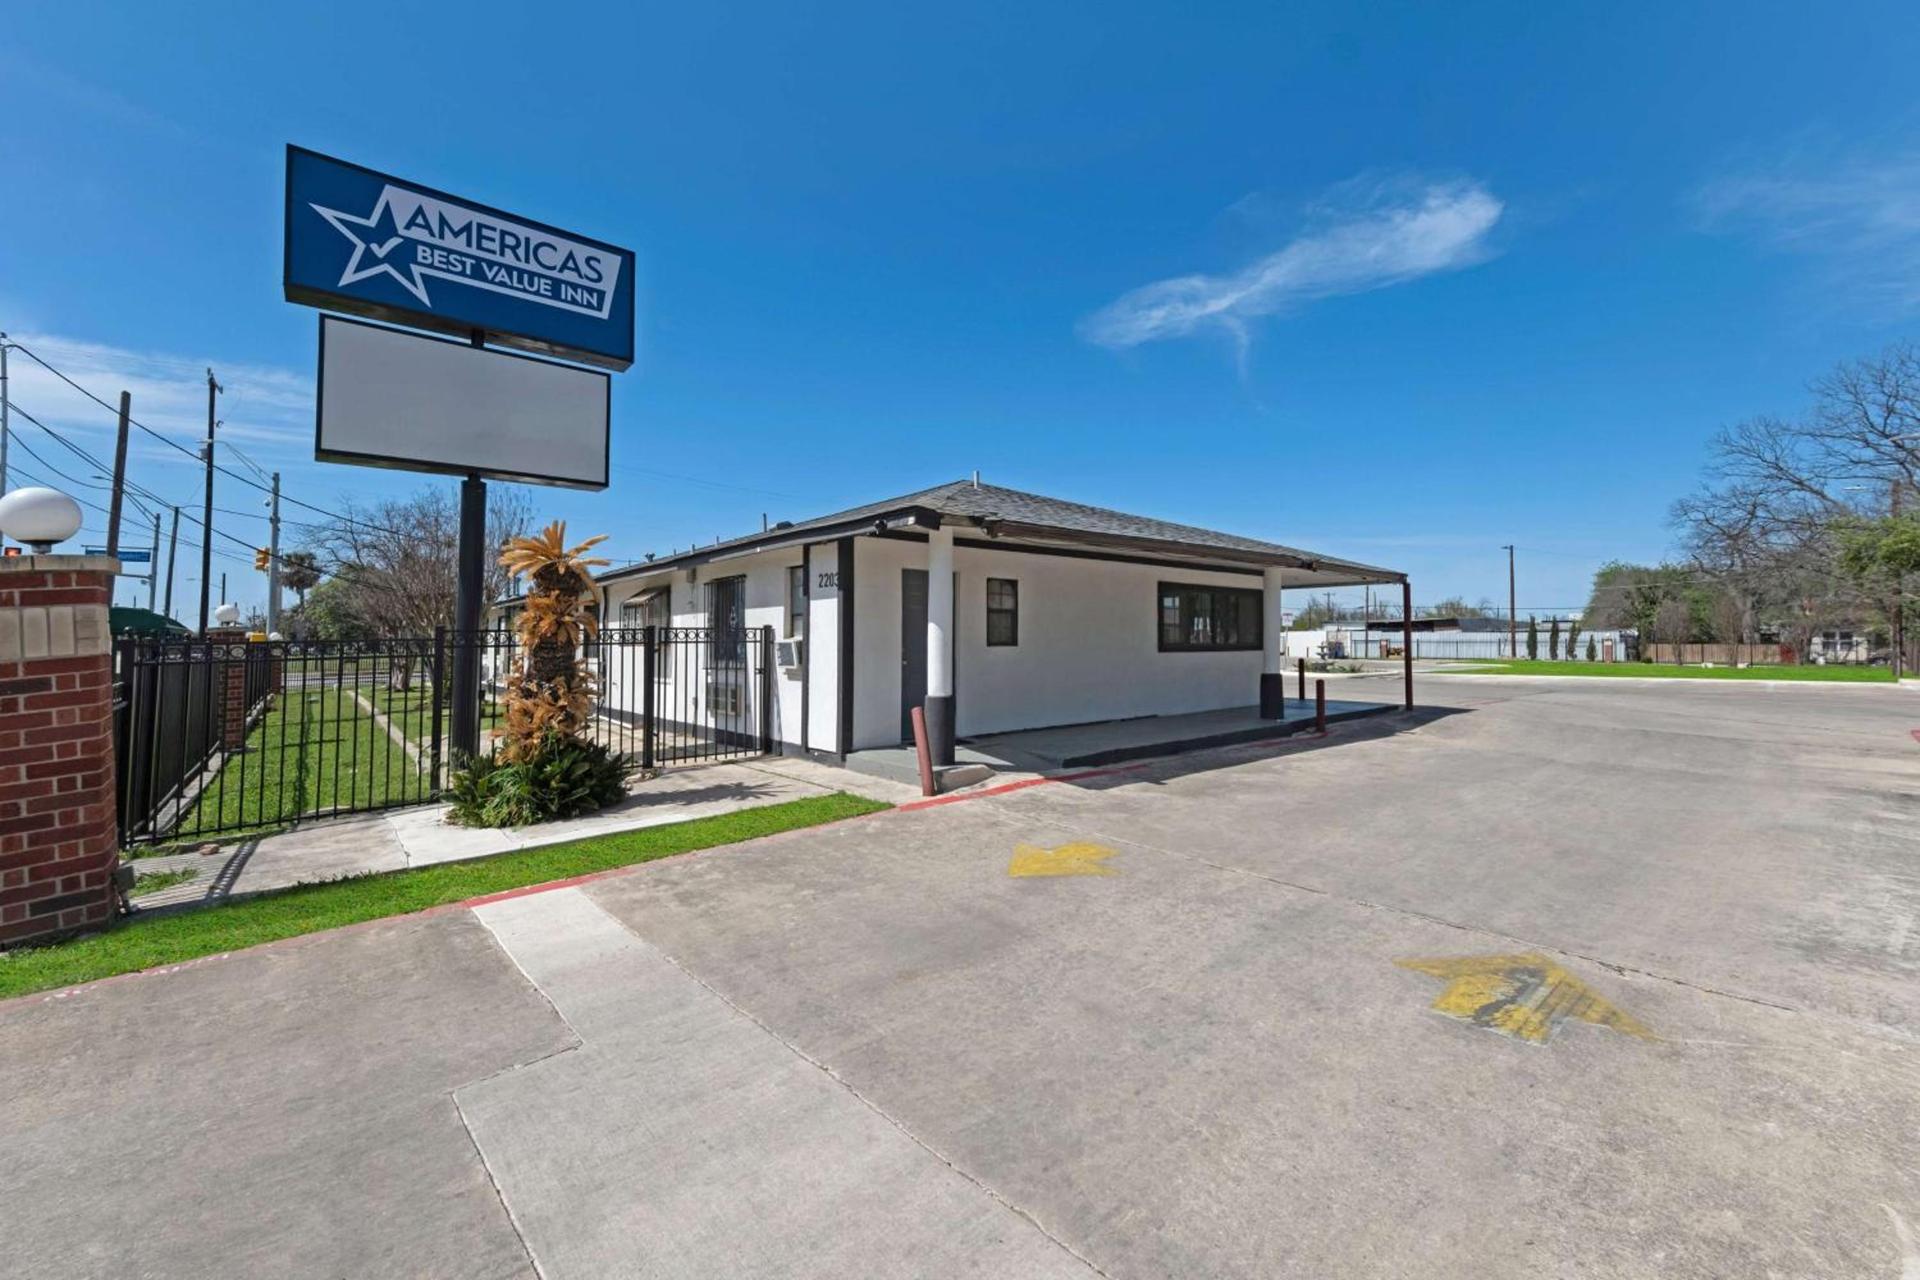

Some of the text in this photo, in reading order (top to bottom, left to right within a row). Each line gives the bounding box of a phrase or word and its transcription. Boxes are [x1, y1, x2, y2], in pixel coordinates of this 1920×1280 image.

[403, 204, 603, 283] AMERICAS
[417, 245, 597, 308] BEST VALUE INN
[819, 572, 841, 588] 2203
